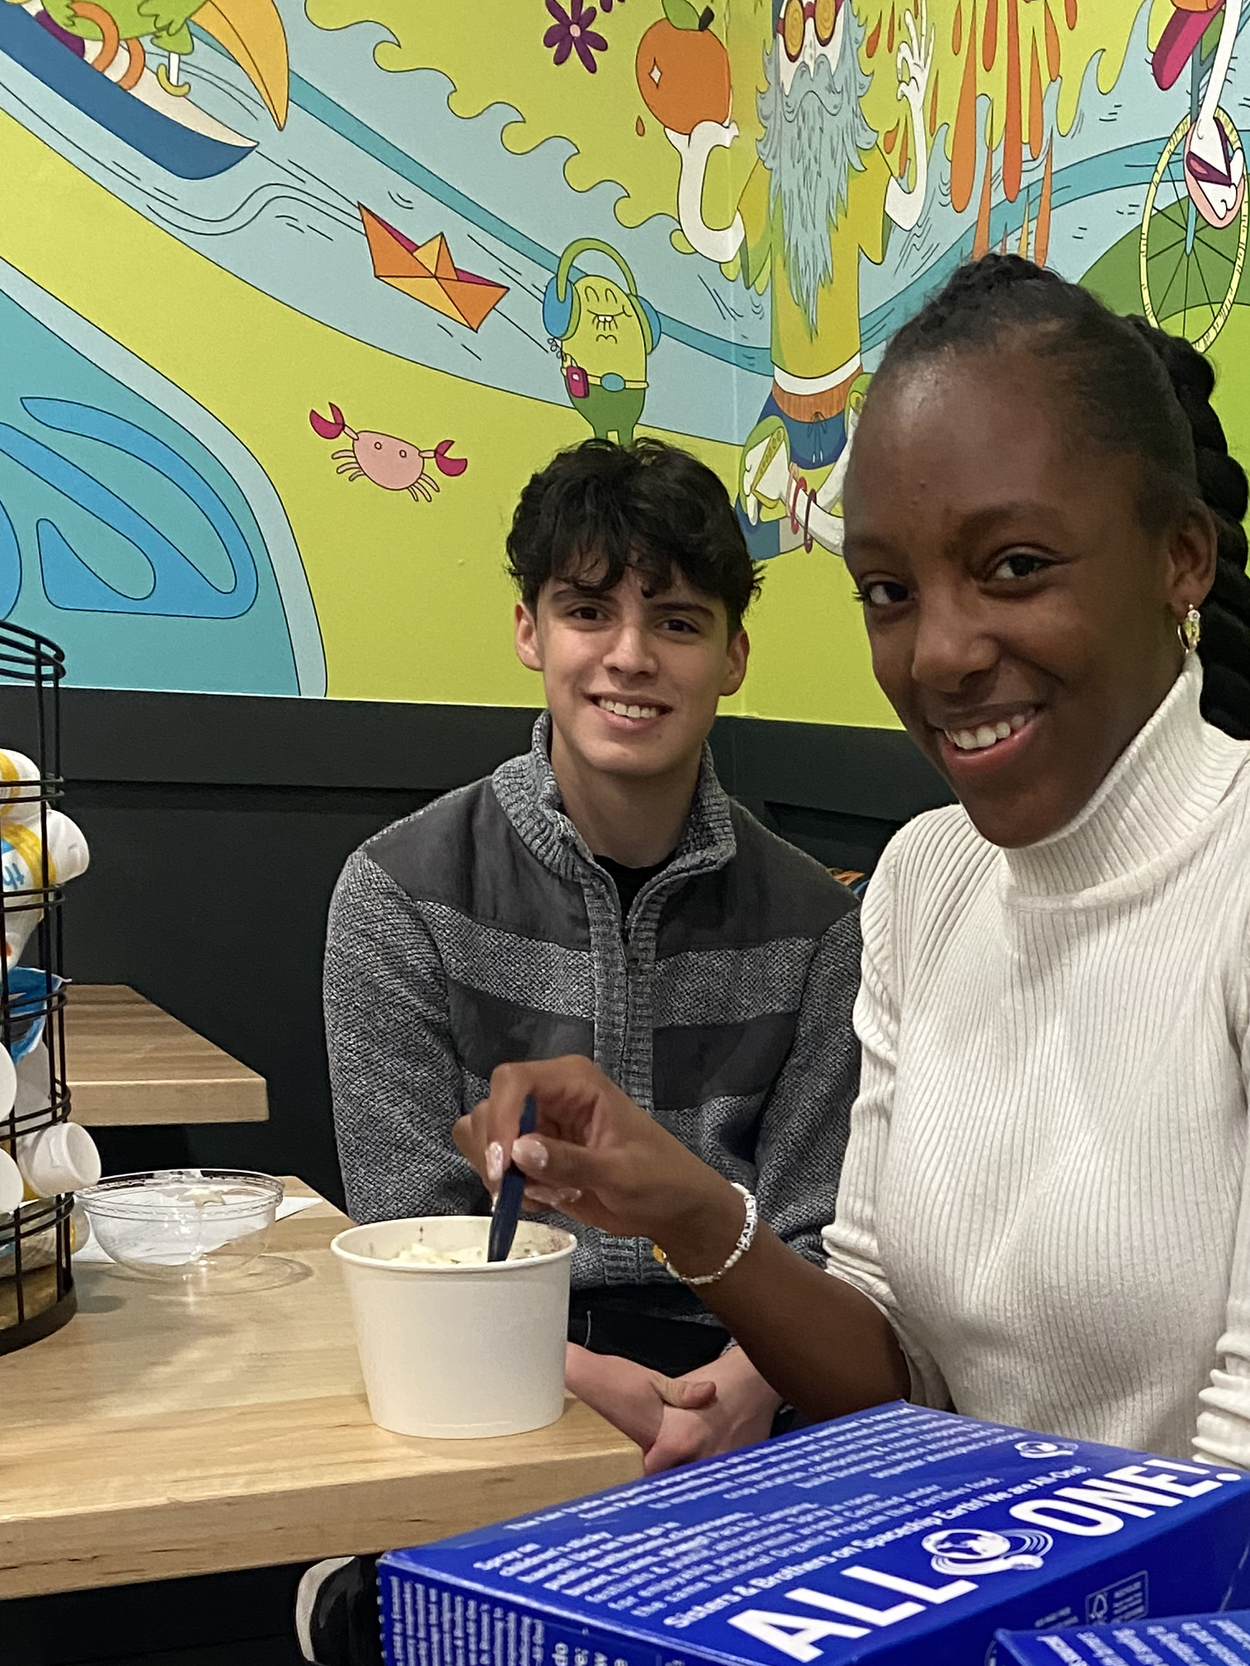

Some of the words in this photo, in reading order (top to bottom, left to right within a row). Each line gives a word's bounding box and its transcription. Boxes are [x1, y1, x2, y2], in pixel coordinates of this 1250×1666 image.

[727, 1566, 978, 1662] ALL
[1009, 1455, 1249, 1536] ONE!
[552, 1643, 568, 1666] do
